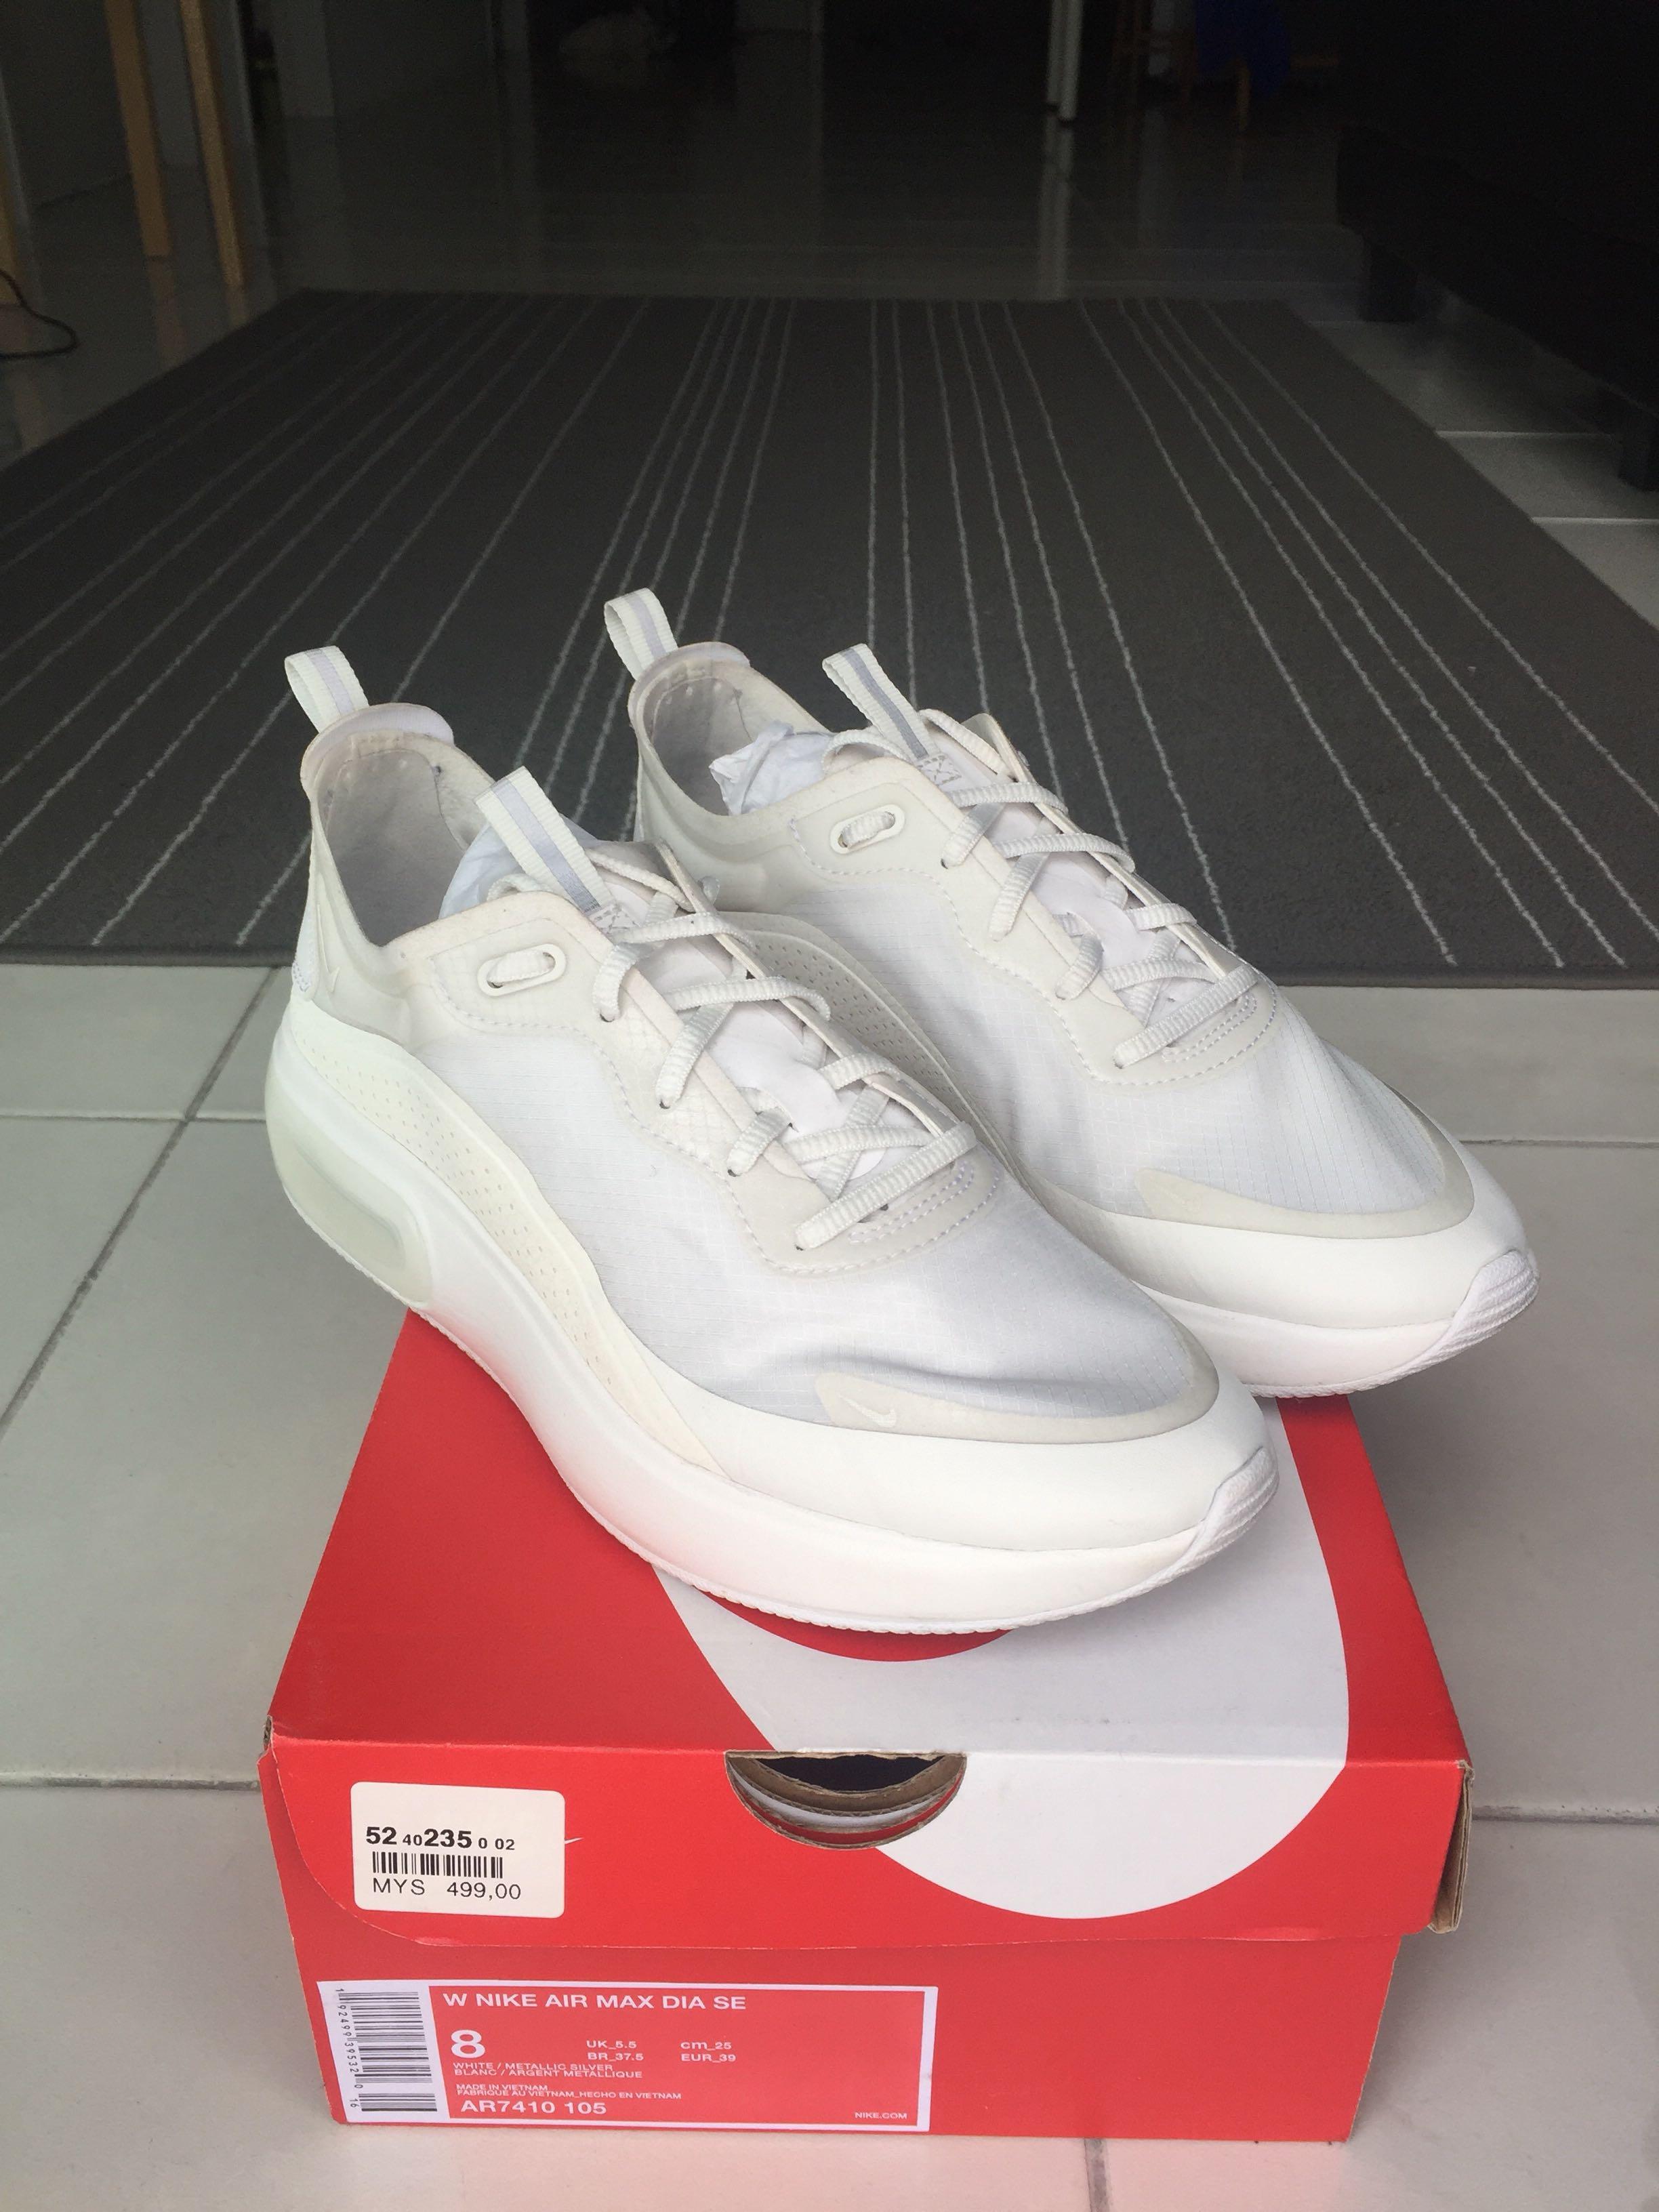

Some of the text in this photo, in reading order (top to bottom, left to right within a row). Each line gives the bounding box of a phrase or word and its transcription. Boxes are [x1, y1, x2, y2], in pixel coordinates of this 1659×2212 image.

[366, 1826, 397, 1845] 52
[478, 1837, 488, 1849] 0
[495, 1838, 515, 1851] 02
[373, 1877, 521, 1901] MYS 499,00
[443, 1993, 746, 2010] W NIKE AIR MAX DIA SE
[451, 2029, 486, 2059] 8
[586, 2040, 637, 2050] UK_5.5
[588, 2052, 644, 2062] BR_37.5
[681, 2053, 736, 2063] EUR_39
[505, 2062, 567, 2070] METALLIC
[564, 2070, 643, 2078] METALLIQUE
[461, 2100, 607, 2114] AR7410 105
[855, 2111, 907, 2119] NIKE.COM
